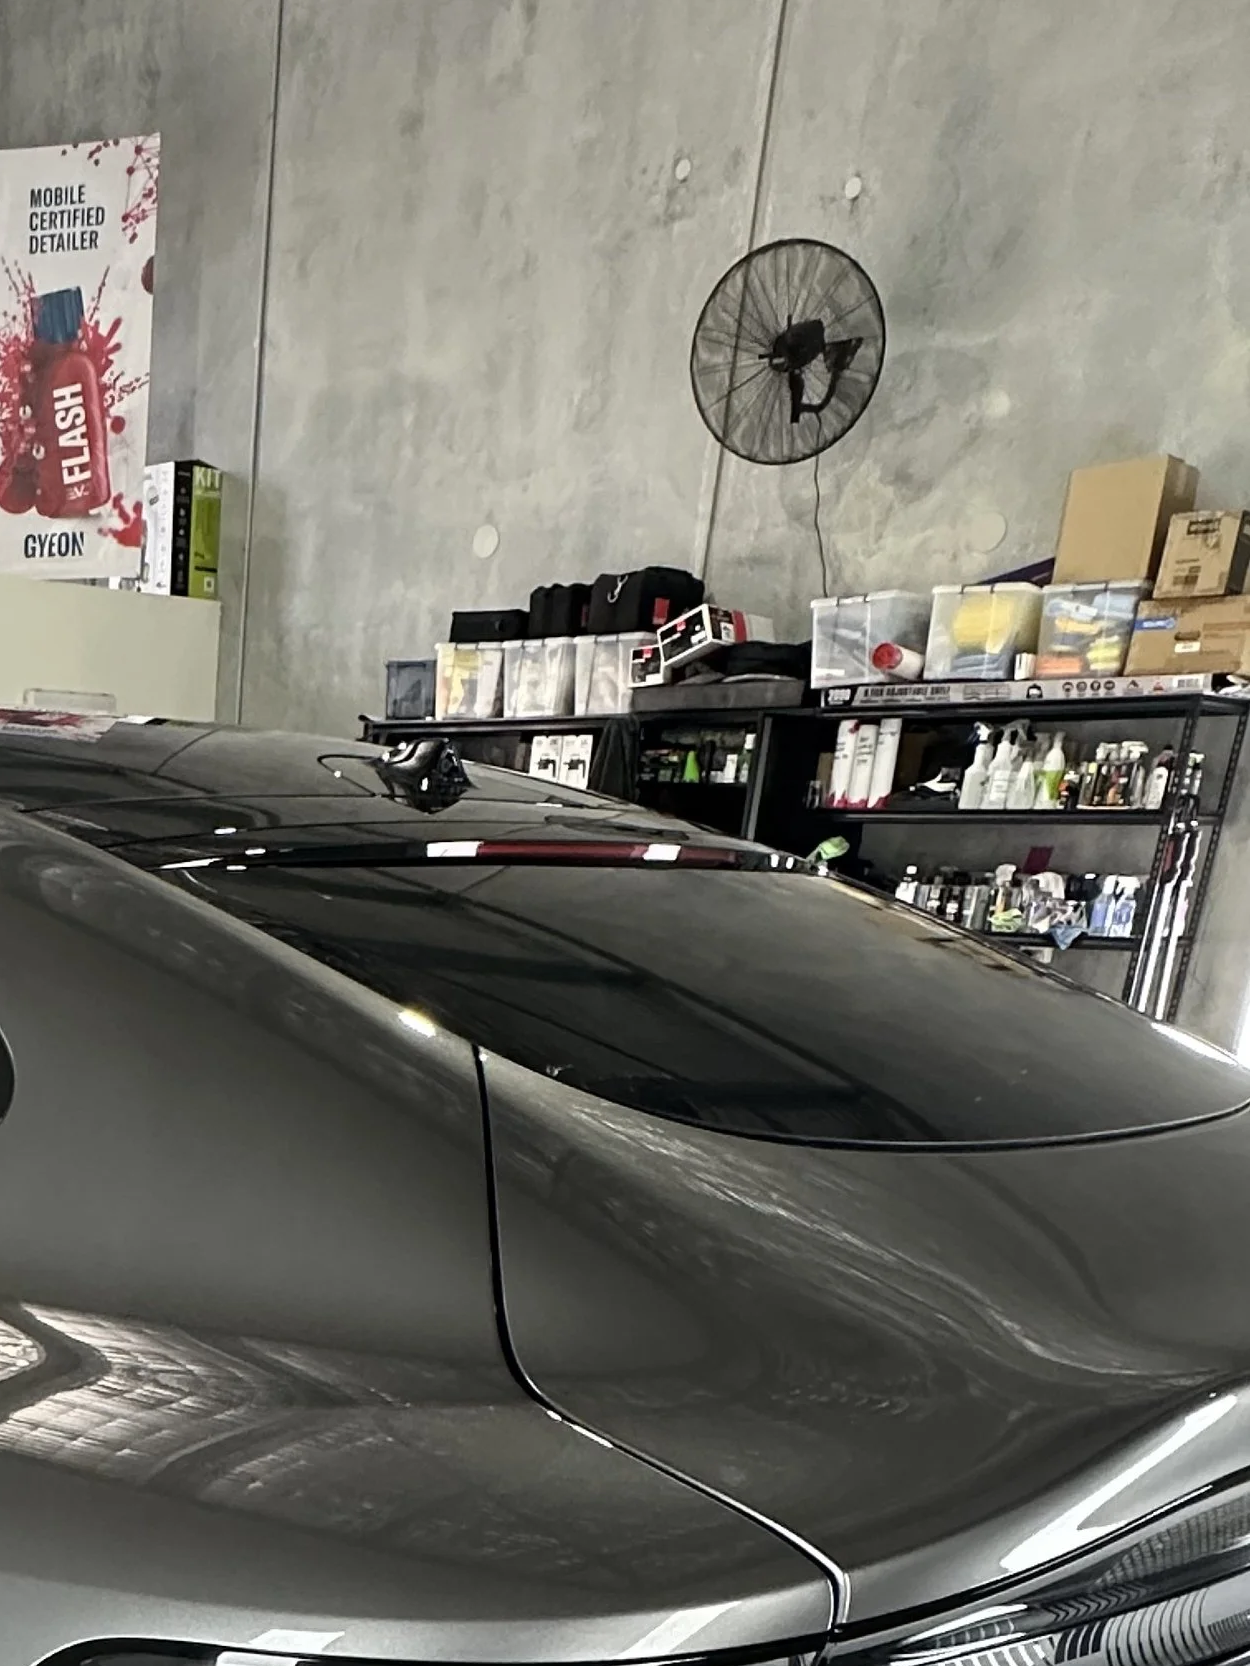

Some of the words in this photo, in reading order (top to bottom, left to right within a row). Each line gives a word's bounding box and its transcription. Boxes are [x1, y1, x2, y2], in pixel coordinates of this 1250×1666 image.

[30, 184, 86, 208] MOBILE
[29, 206, 106, 231] CERTIFIED
[29, 230, 99, 254] DETAILER
[53, 383, 92, 485] FLASH
[193, 465, 221, 489] KIT
[24, 531, 85, 559] GYEON
